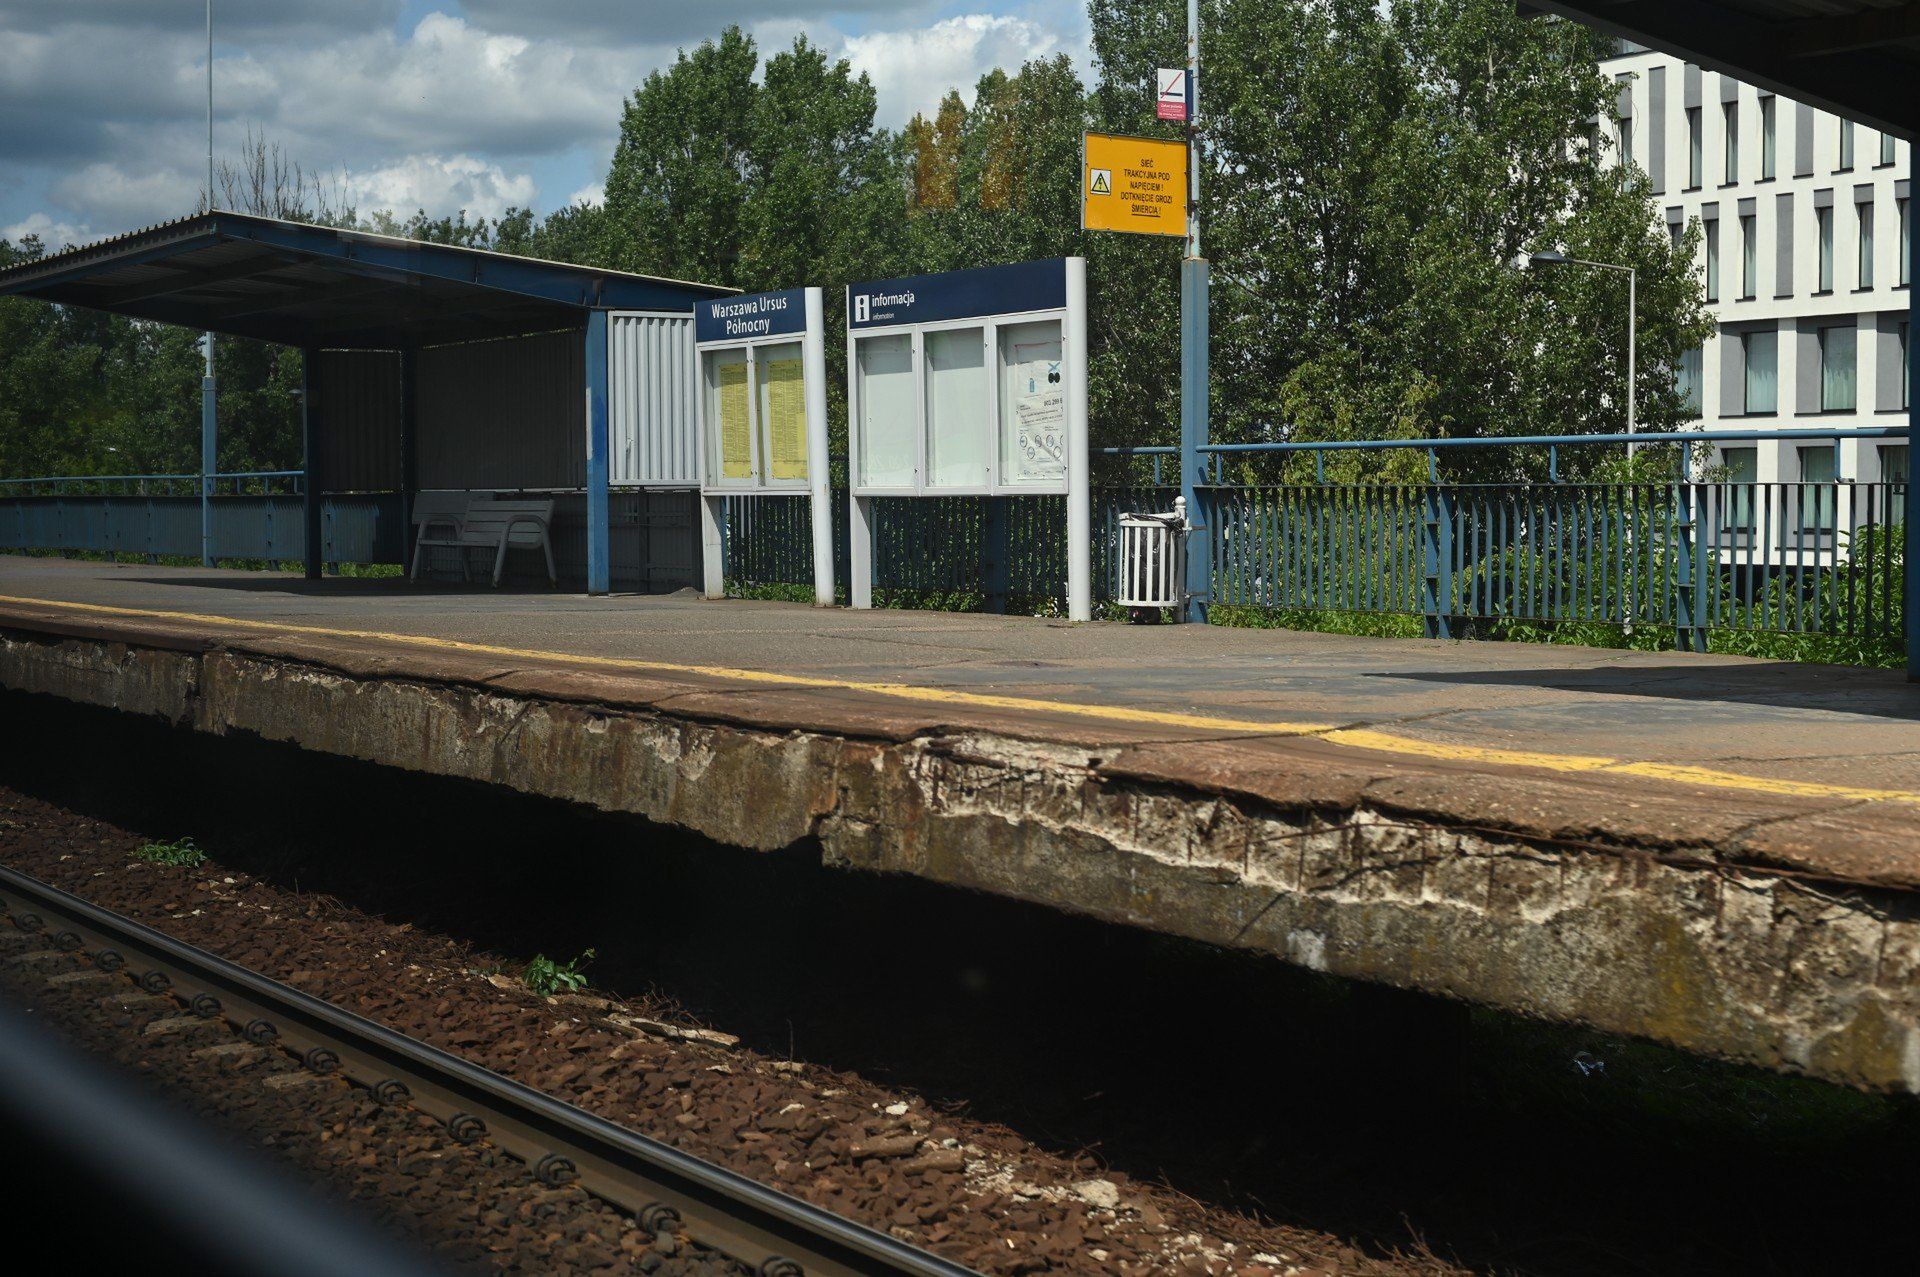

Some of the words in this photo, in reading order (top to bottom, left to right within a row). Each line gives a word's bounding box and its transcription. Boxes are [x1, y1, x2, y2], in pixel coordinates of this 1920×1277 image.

[1124, 168, 1157, 180] TRAKCYJNA
[1157, 172, 1171, 181] POD
[1130, 181, 1160, 192] NAPIĘCIEM
[1120, 191, 1154, 203] DOTKNIĘCIE
[1155, 194, 1173, 204] GROZI
[872, 290, 915, 307] informacja
[712, 301, 758, 319] Warszawa
[760, 297, 787, 312] Ursus
[726, 318, 770, 335] Północny
